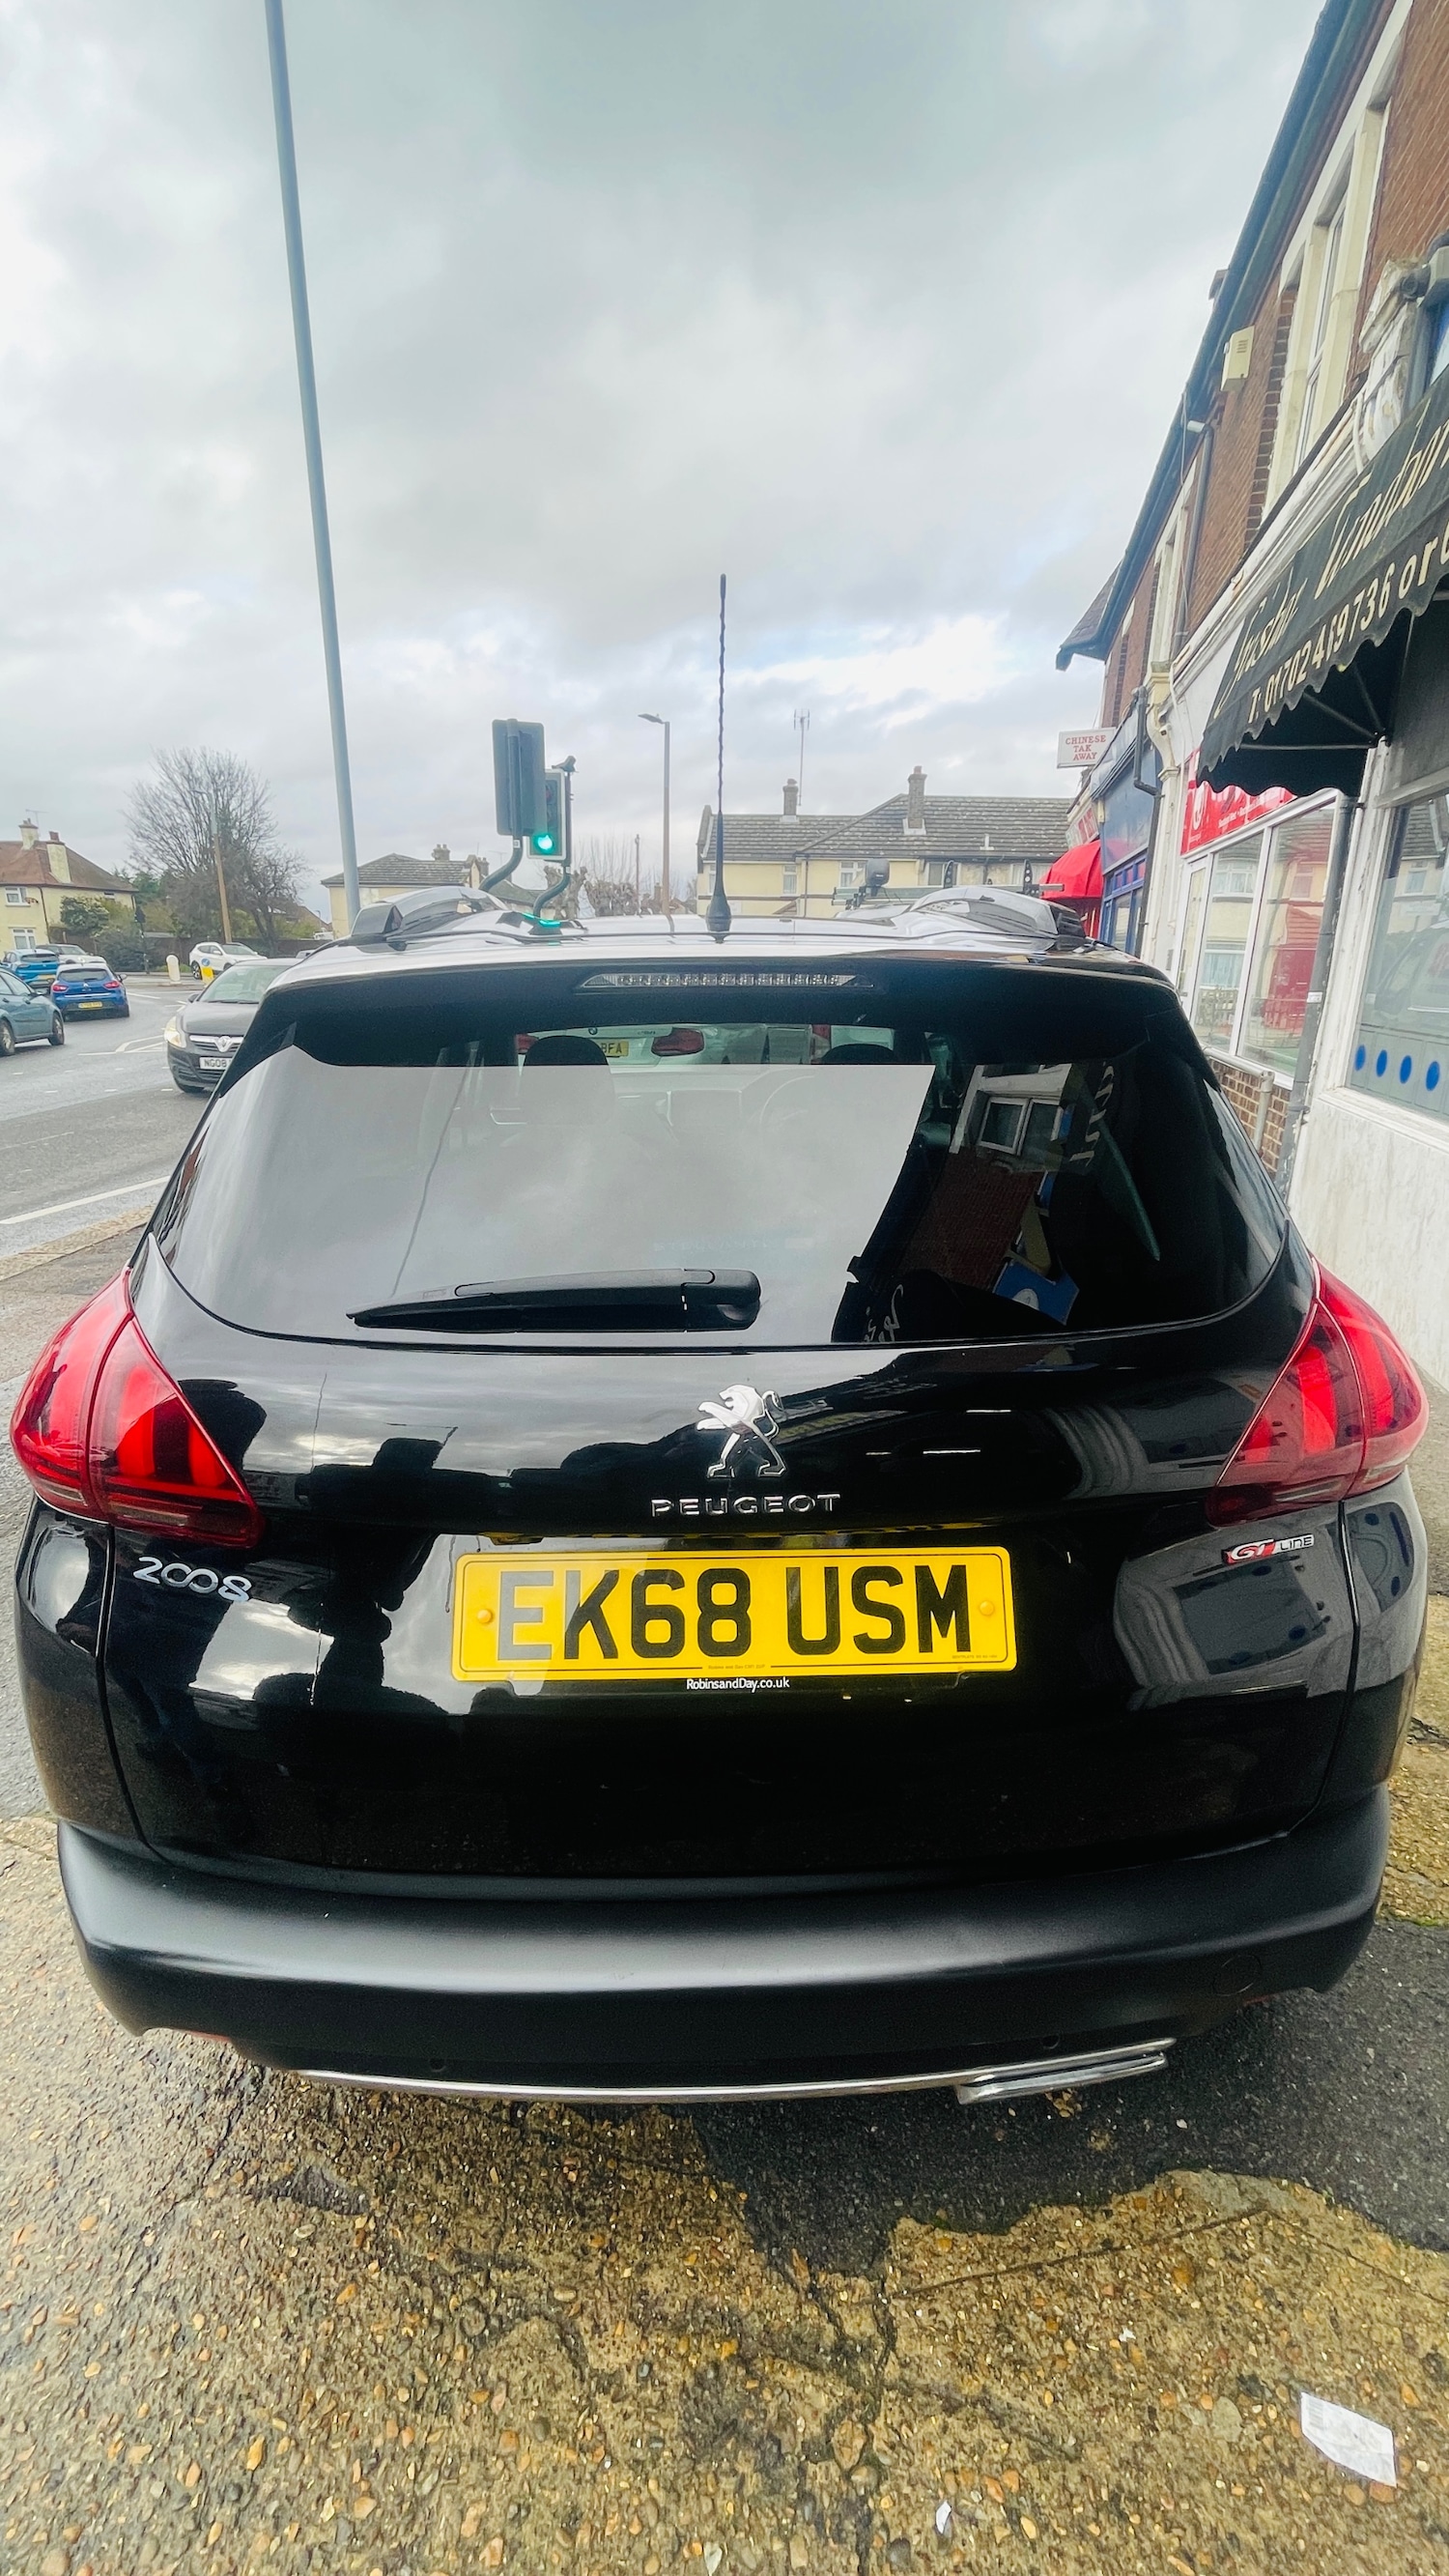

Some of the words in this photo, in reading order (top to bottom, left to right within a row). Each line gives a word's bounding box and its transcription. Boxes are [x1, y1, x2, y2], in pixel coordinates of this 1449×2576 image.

[1398, 535, 1439, 600] or
[1065, 734, 1107, 745] CHINESE
[1073, 744, 1093, 753] TAK
[1073, 752, 1097, 761] AWAY
[651, 1493, 841, 1518] PEUGEOT
[1231, 1538, 1275, 1560] GT
[132, 1556, 253, 1603] 2008
[497, 1567, 752, 1661] EK68
[785, 1563, 972, 1657] USM
[686, 1676, 790, 1694] RobinsandDay.co.uk
